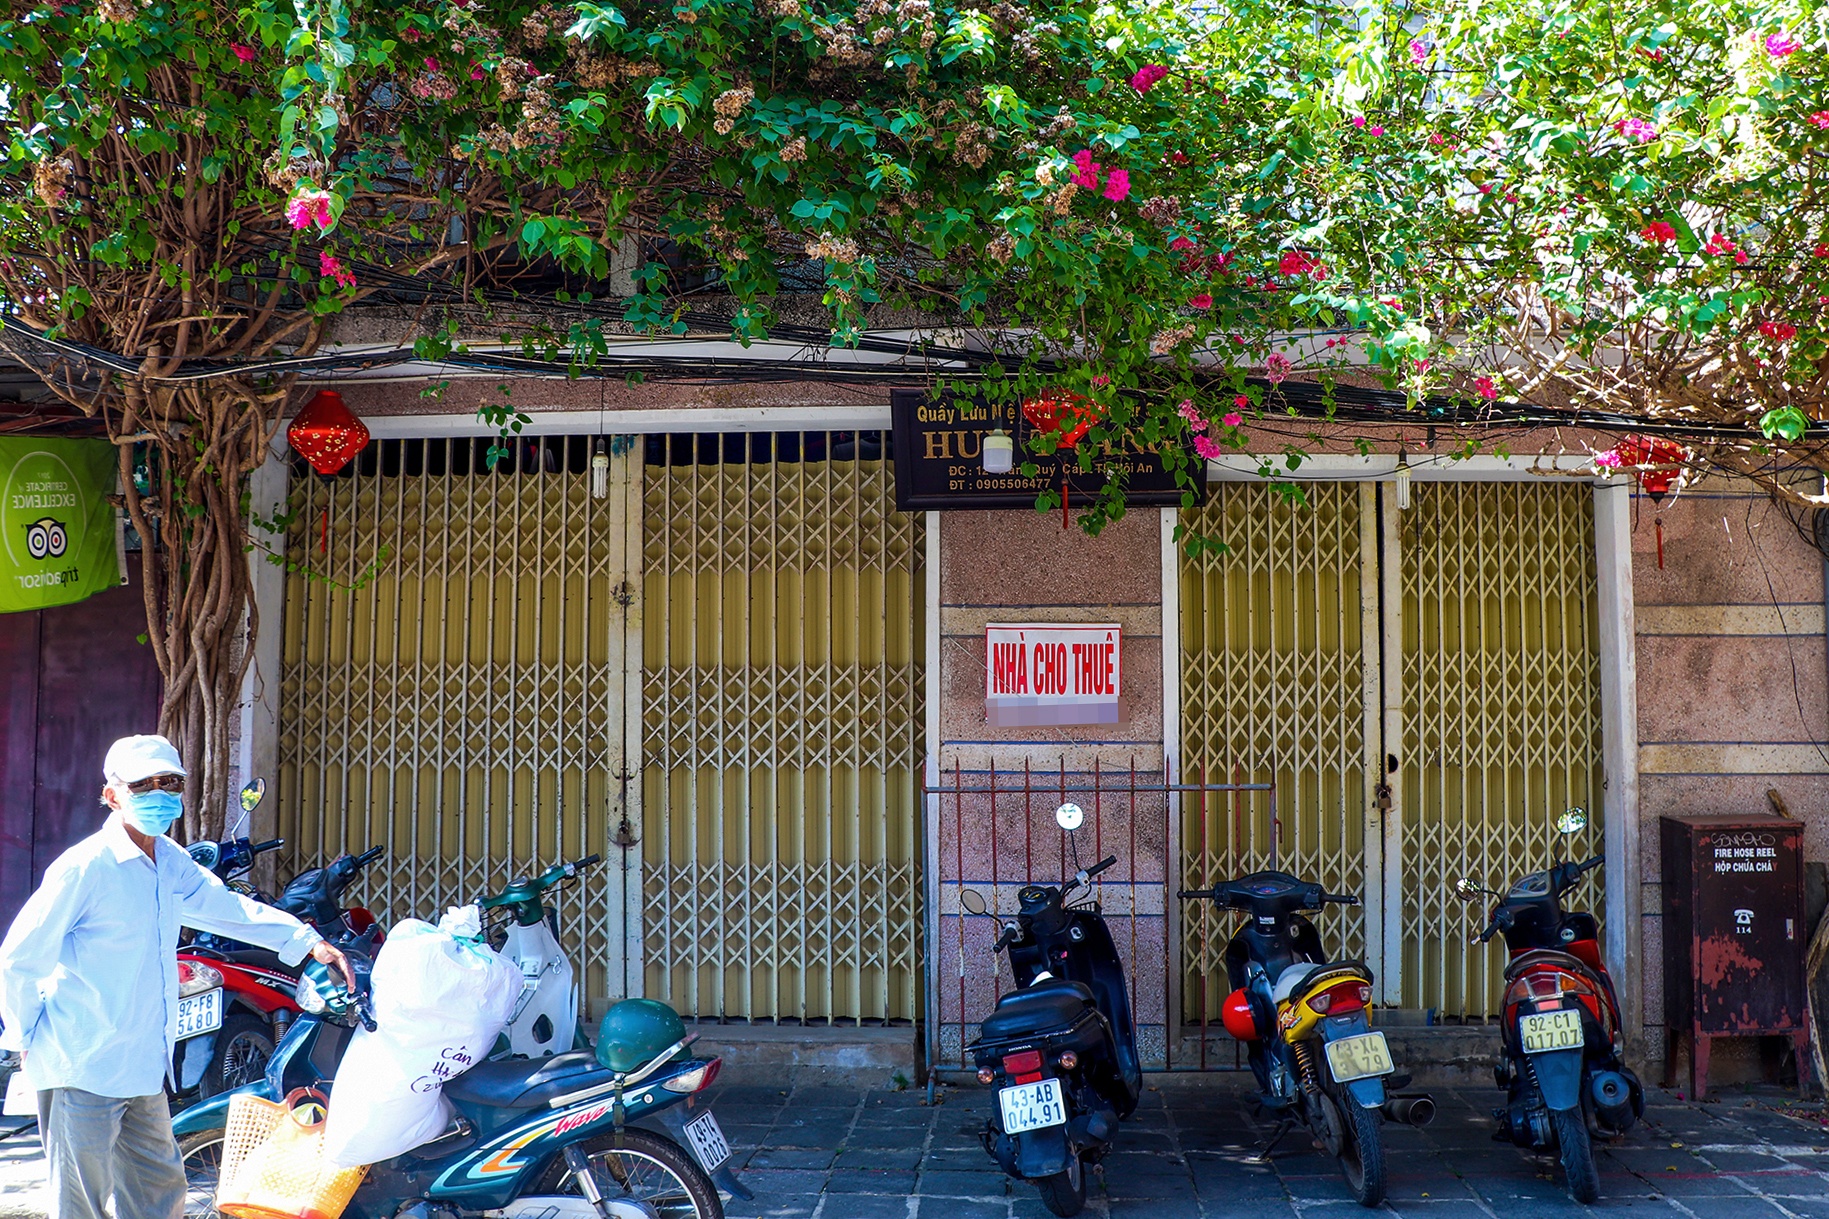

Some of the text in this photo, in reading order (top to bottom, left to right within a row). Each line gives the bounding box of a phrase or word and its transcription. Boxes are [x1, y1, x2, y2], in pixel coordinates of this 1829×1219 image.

[917, 402, 955, 424] Quầy
[1136, 462, 1153, 474] An
[976, 478, 1050, 490] 0905506477
[993, 632, 1114, 695] NHÀ CHO THUÊ
[1714, 847, 1777, 858] FIRE HOSE REEL
[1714, 860, 1731, 875] HỘP
[1736, 926, 1751, 934] 114
[255, 976, 281, 988] MX
[178, 993, 214, 1018] 92-F8
[177, 1010, 214, 1035] 5480
[1529, 1013, 1570, 1033] 92-C1
[1526, 1029, 1578, 1050] 017.07
[1011, 1083, 1053, 1109] 43-AB
[554, 1106, 610, 1137] Wave
[1008, 1102, 1062, 1130] 044.91
